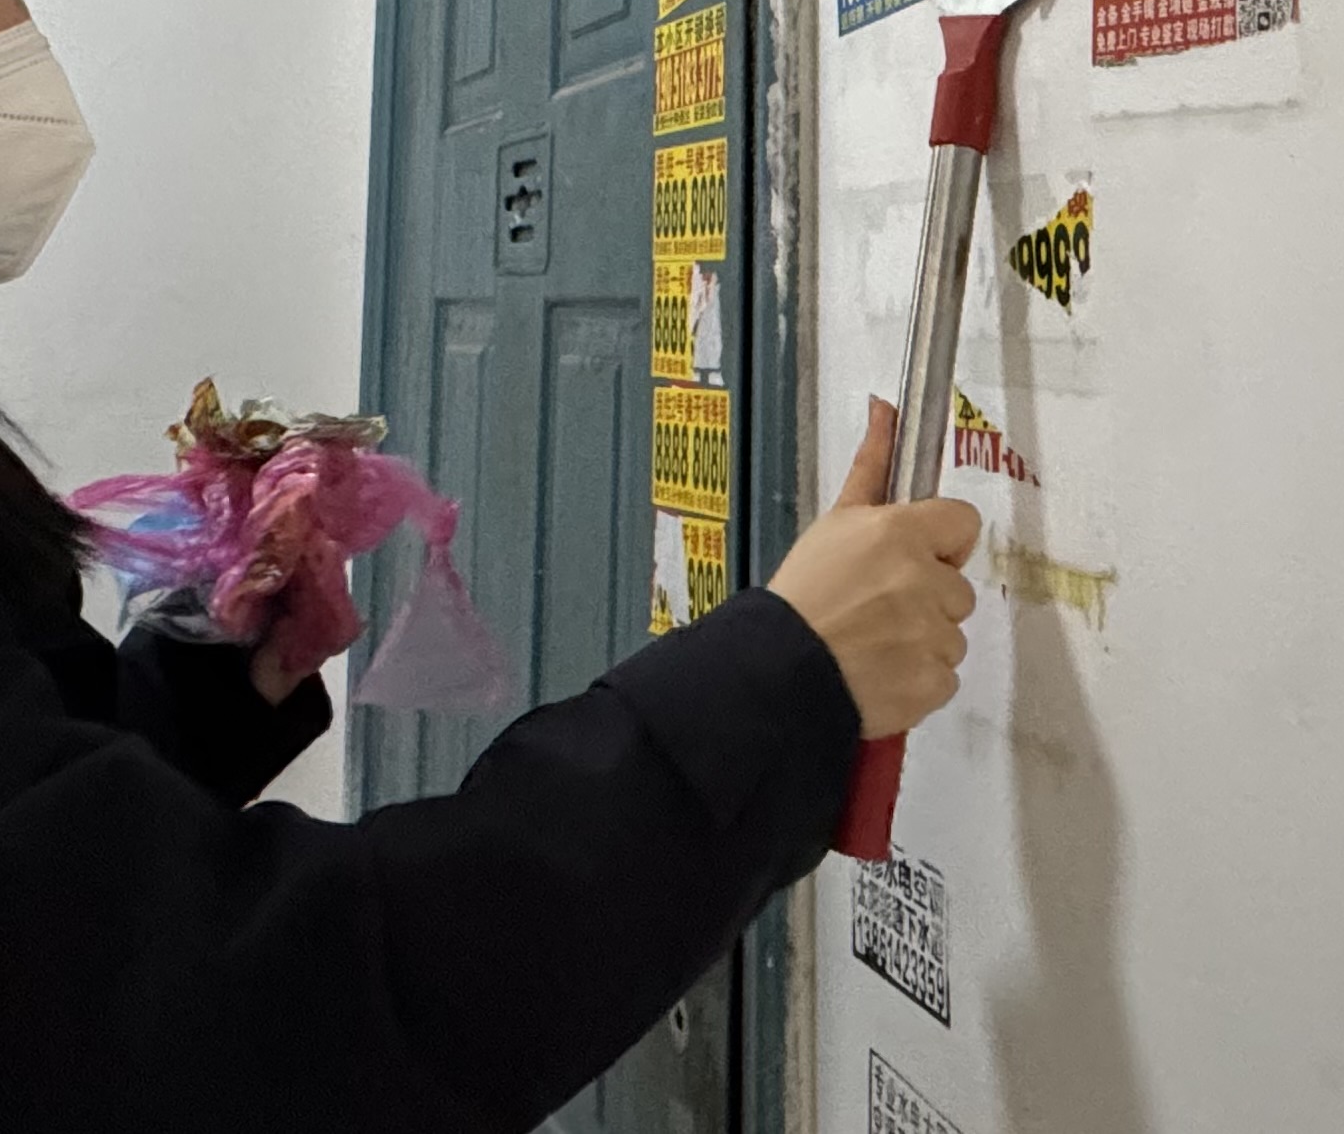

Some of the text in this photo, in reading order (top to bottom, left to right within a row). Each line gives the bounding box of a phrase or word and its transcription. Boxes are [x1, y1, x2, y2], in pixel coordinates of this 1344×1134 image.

[1096, 28, 1137, 53] 免费上门
[655, 174, 725, 238] 8888 8080
[1009, 221, 1091, 307] 9999
[655, 296, 687, 355] 8888
[656, 422, 728, 495] 8888 8080
